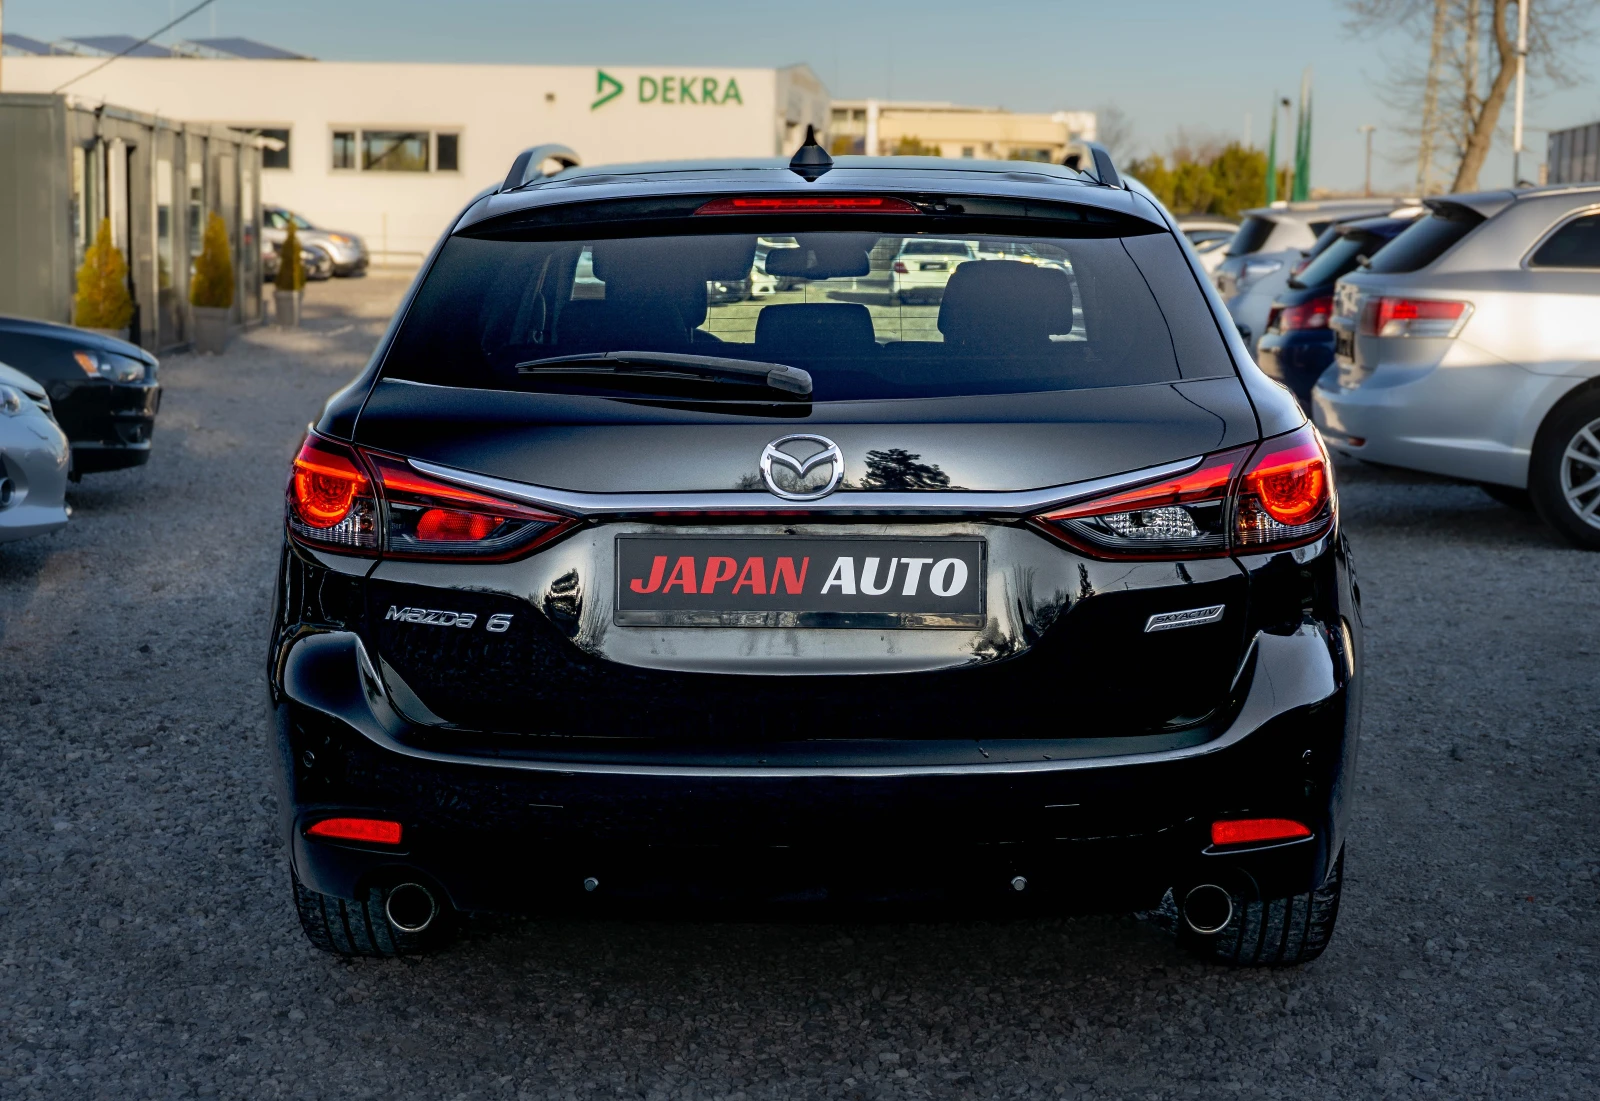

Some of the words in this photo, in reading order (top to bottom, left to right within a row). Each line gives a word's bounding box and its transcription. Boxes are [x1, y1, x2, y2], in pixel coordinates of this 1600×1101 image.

[638, 76, 743, 105] DEKRA
[630, 556, 809, 594] JAPAN
[821, 556, 968, 597] AUTO
[485, 613, 514, 633] 6
[1155, 607, 1218, 623] SKYACTIV
